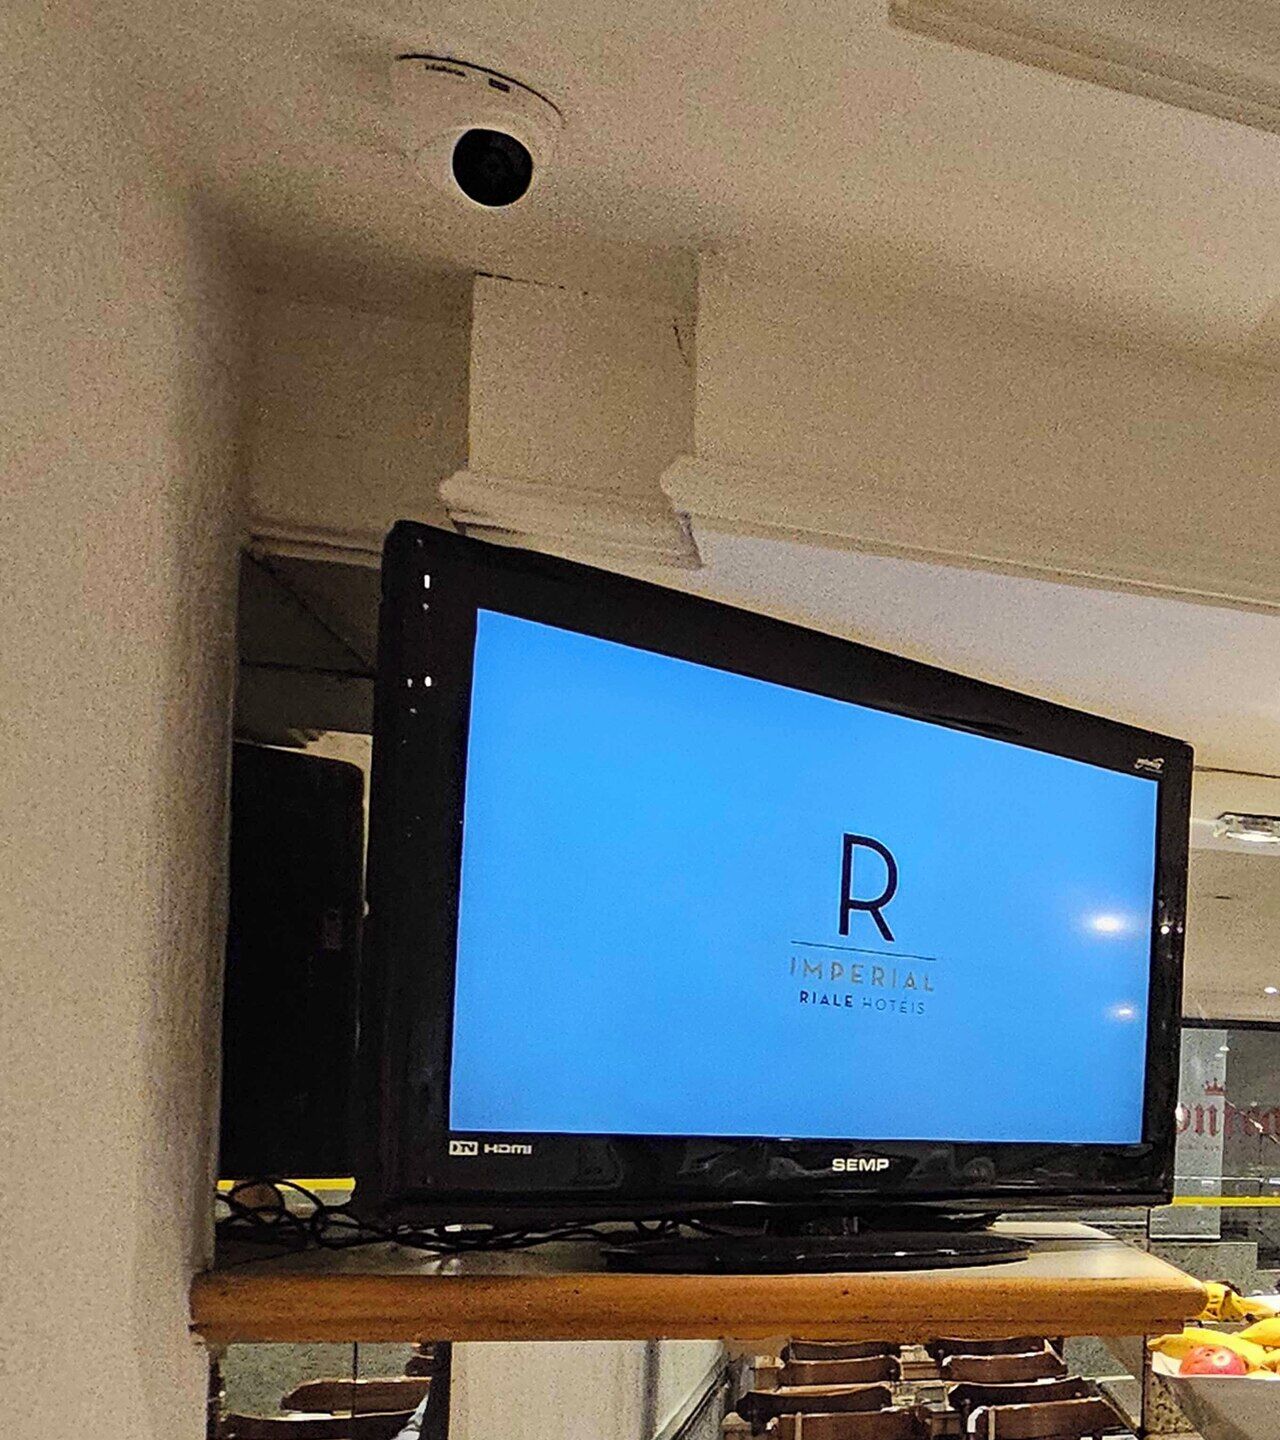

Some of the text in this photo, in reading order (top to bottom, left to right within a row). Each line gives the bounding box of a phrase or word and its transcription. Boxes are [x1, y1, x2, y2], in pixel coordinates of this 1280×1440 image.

[838, 832, 898, 942] R
[789, 957, 935, 993] IMPERIAL
[799, 990, 854, 1008] RIALE
[483, 1143, 533, 1155] HDMI
[831, 1158, 890, 1172] SEMP
